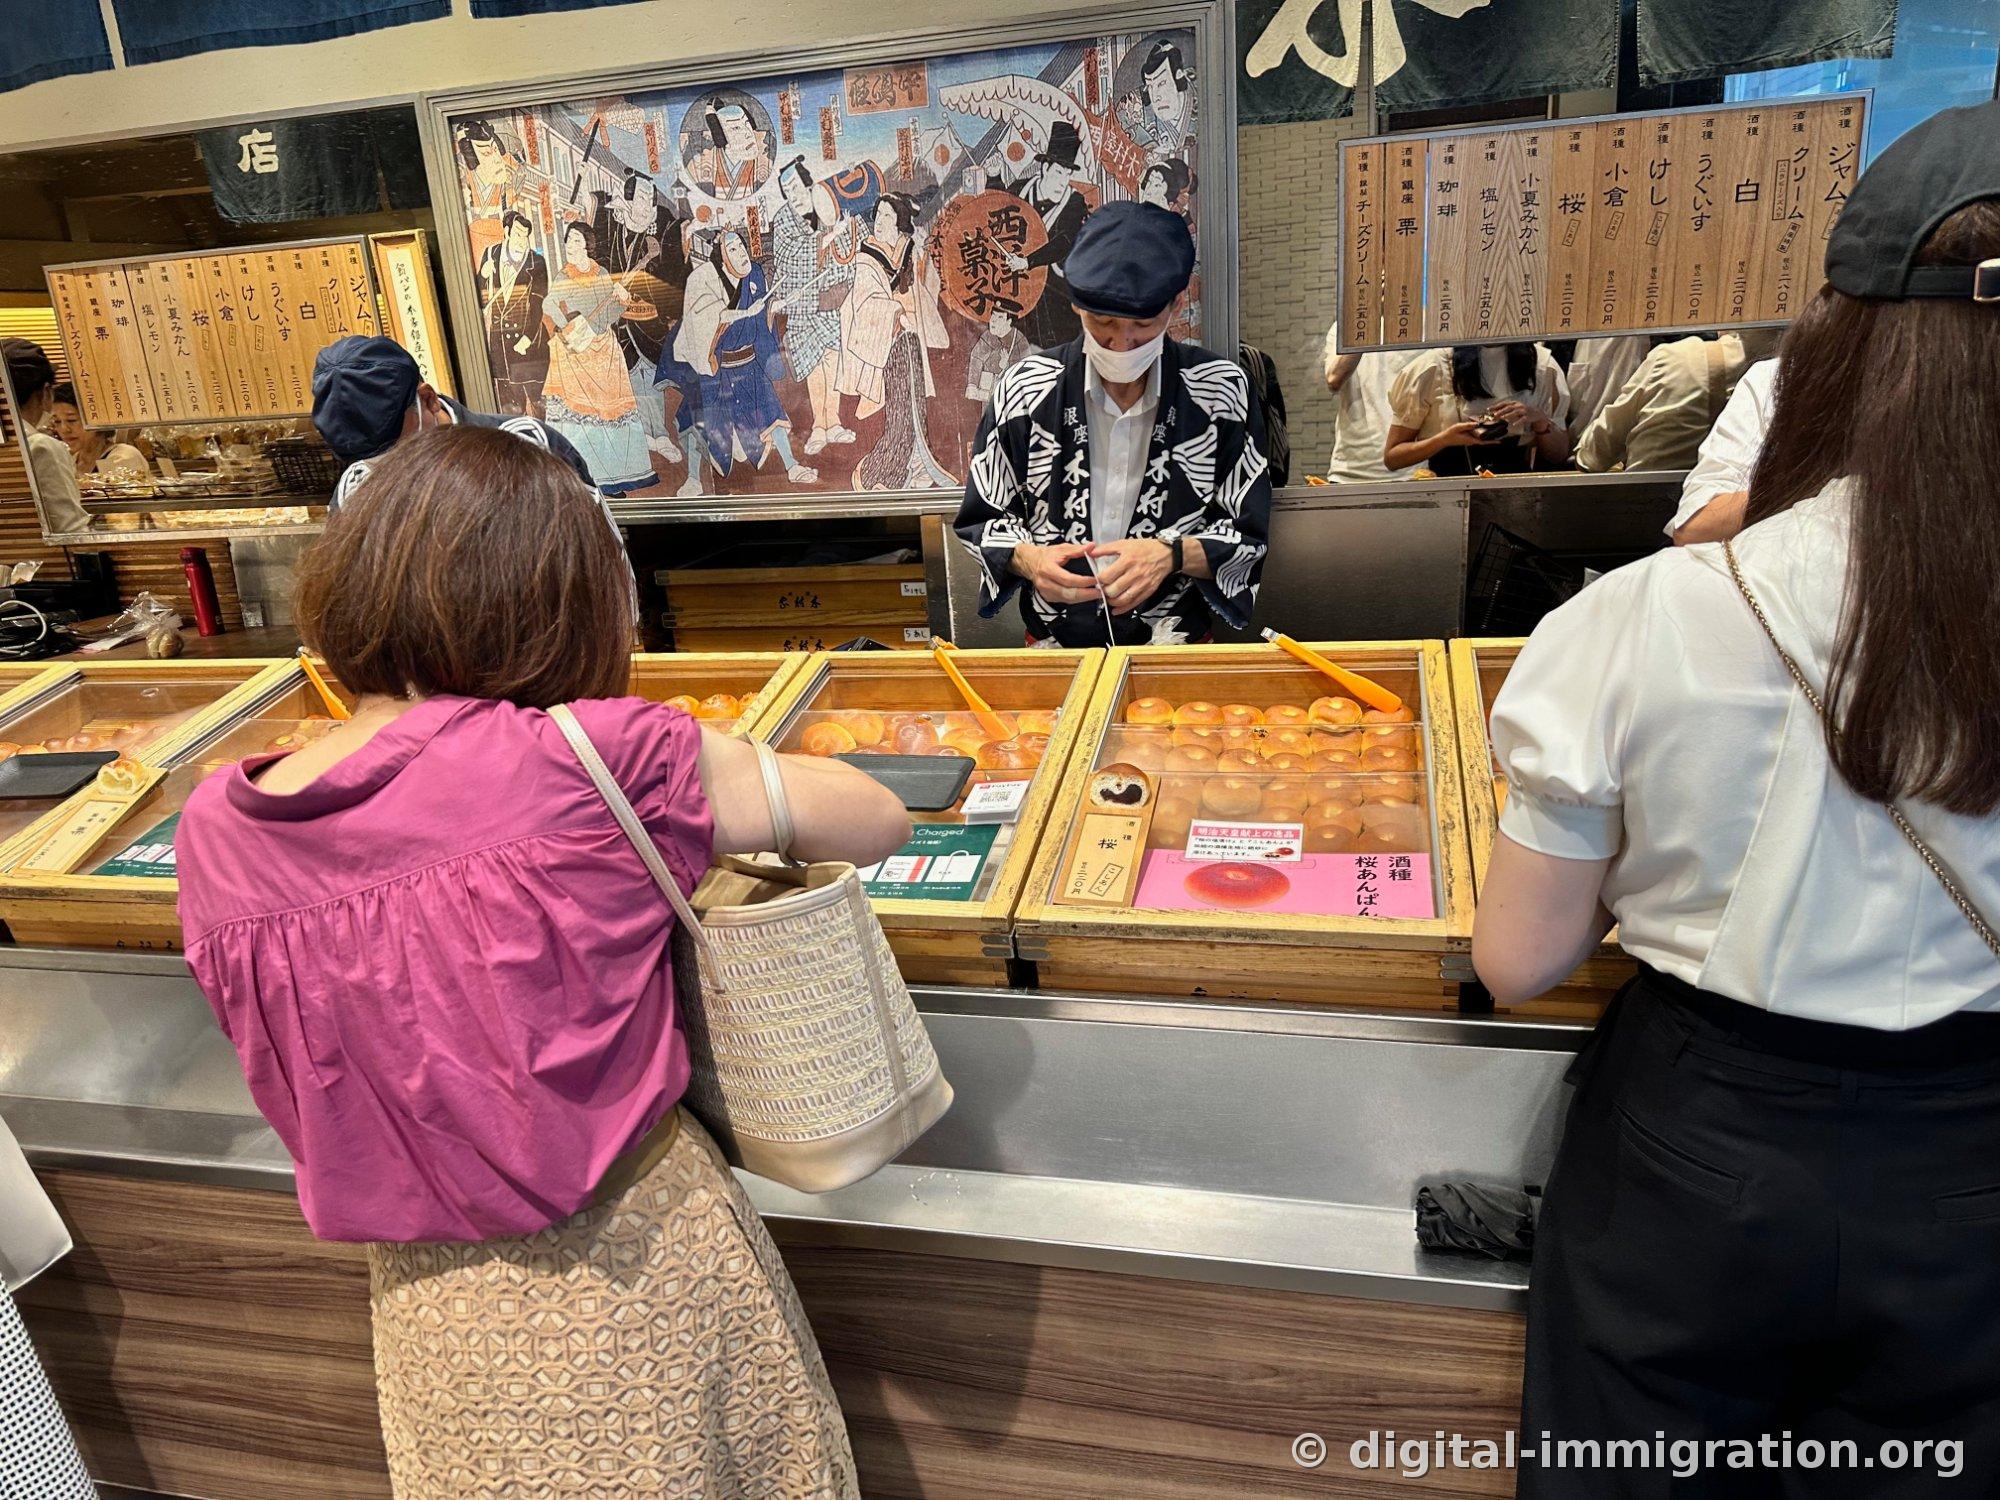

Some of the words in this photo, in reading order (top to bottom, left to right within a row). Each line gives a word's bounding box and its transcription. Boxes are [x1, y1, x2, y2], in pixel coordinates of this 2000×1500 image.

[237, 128, 279, 174] 店
[1824, 142, 1856, 202] ジャム
[1437, 180, 1459, 217] 珈琲
[1558, 193, 1586, 215] 桜
[1603, 163, 1628, 207] 小倉
[1650, 158, 1671, 206] けし
[1691, 154, 1714, 232] うぐいす
[1735, 178, 1760, 203] 白
[1787, 147, 1809, 220] クリーム
[1396, 217, 1418, 236] 栗
[1480, 188, 1499, 252] 塩レモン
[1518, 173, 1540, 255] 小夏みかん
[1356, 200, 1373, 286] チーズクリーム
[111, 299, 129, 327] 珈琲
[192, 309, 210, 326] 桜
[215, 288, 234, 321] 小倉
[242, 285, 260, 321] けし
[271, 282, 291, 341] うぐいす
[300, 301, 316, 320] 白
[329, 278, 348, 332] クリーム
[350, 275, 372, 320] ジャム
[65, 312, 90, 377] チーズクリーム
[95, 326, 109, 341] 栗
[142, 304, 160, 353] 塩レモン
[164, 294, 190, 356] 小夏みかん
[917, 828, 965, 837] Charged
[1098, 838, 1117, 849] 桜
[1355, 856, 1379, 916] 桜あんぱん
[1388, 856, 1412, 881] 酒種
